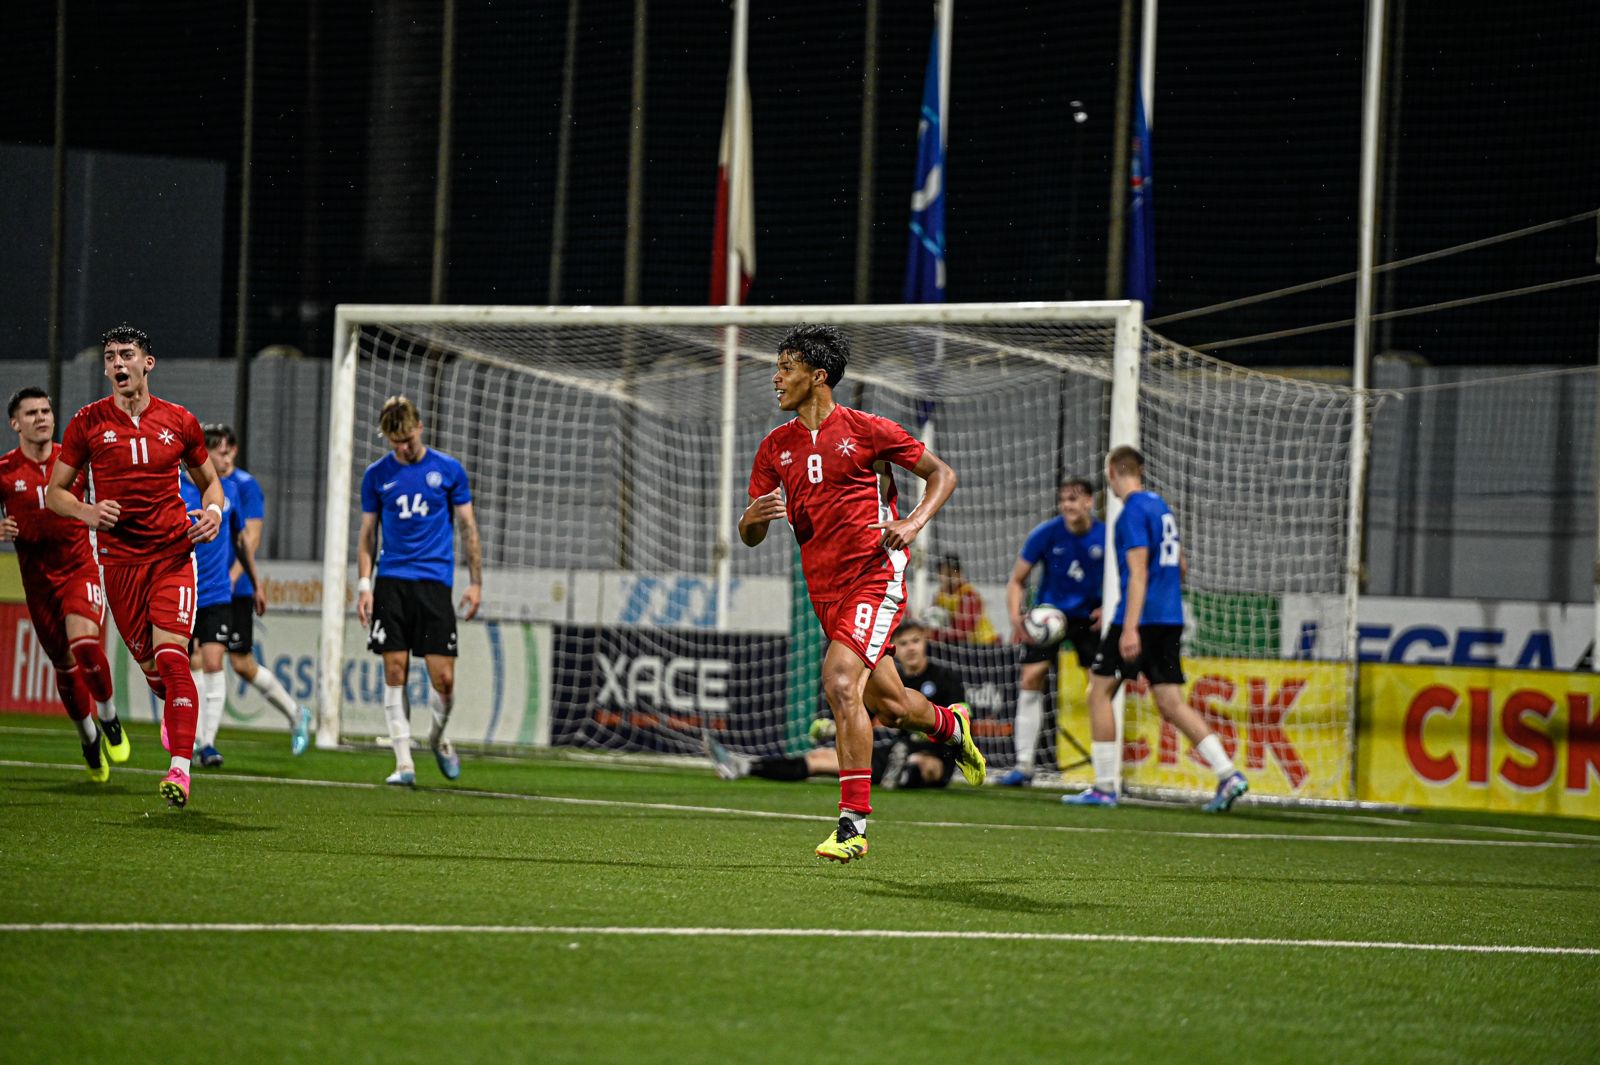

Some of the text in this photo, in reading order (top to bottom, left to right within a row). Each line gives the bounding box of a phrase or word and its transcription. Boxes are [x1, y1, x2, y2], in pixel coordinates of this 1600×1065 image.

[130, 437, 149, 465] 11
[807, 454, 823, 484] 8
[396, 493, 429, 520] 14
[1066, 559, 1085, 582] 4
[86, 582, 102, 607] 18
[178, 586, 192, 612] 11
[854, 603, 873, 630] 8
[368, 619, 387, 645] 4
[11, 618, 63, 703] FIA
[595, 652, 731, 712] XACE
